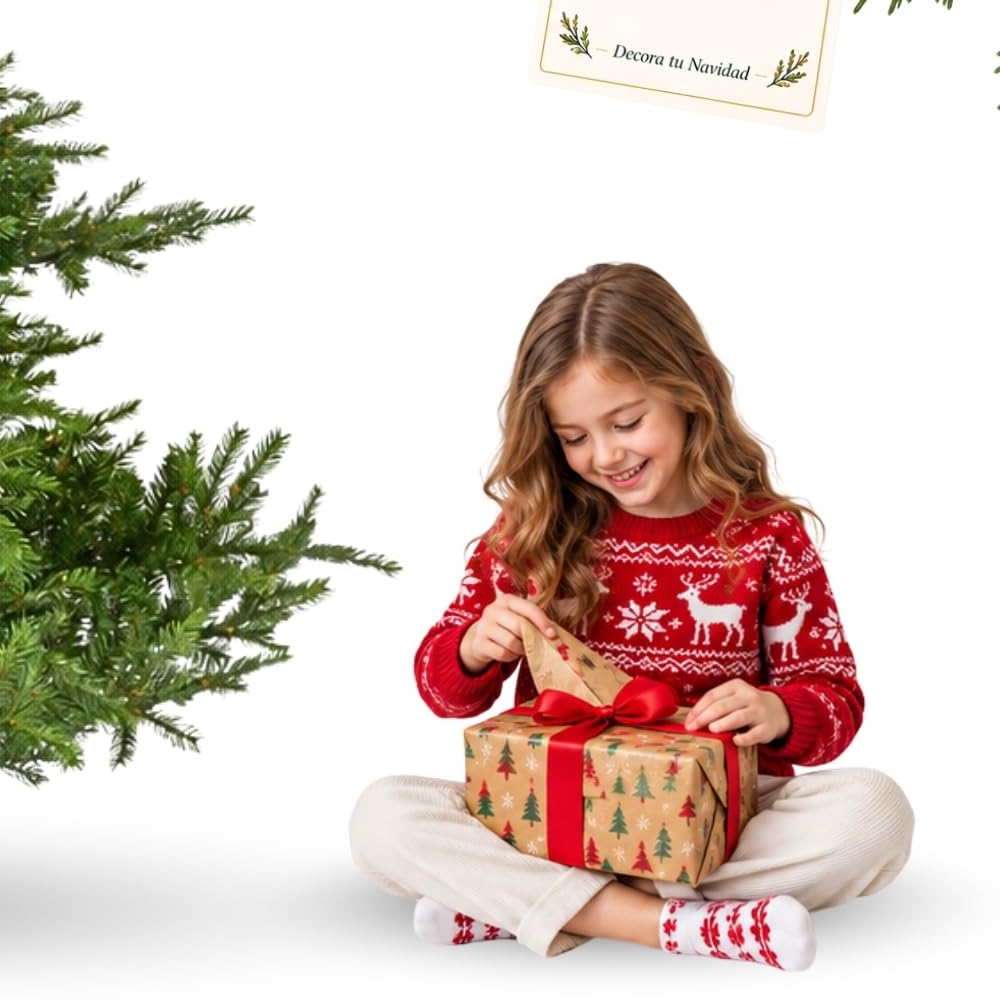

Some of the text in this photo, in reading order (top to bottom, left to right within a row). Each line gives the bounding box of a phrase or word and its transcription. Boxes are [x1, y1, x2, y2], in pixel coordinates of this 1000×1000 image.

[612, 43, 751, 81] Decora tu Navidad
